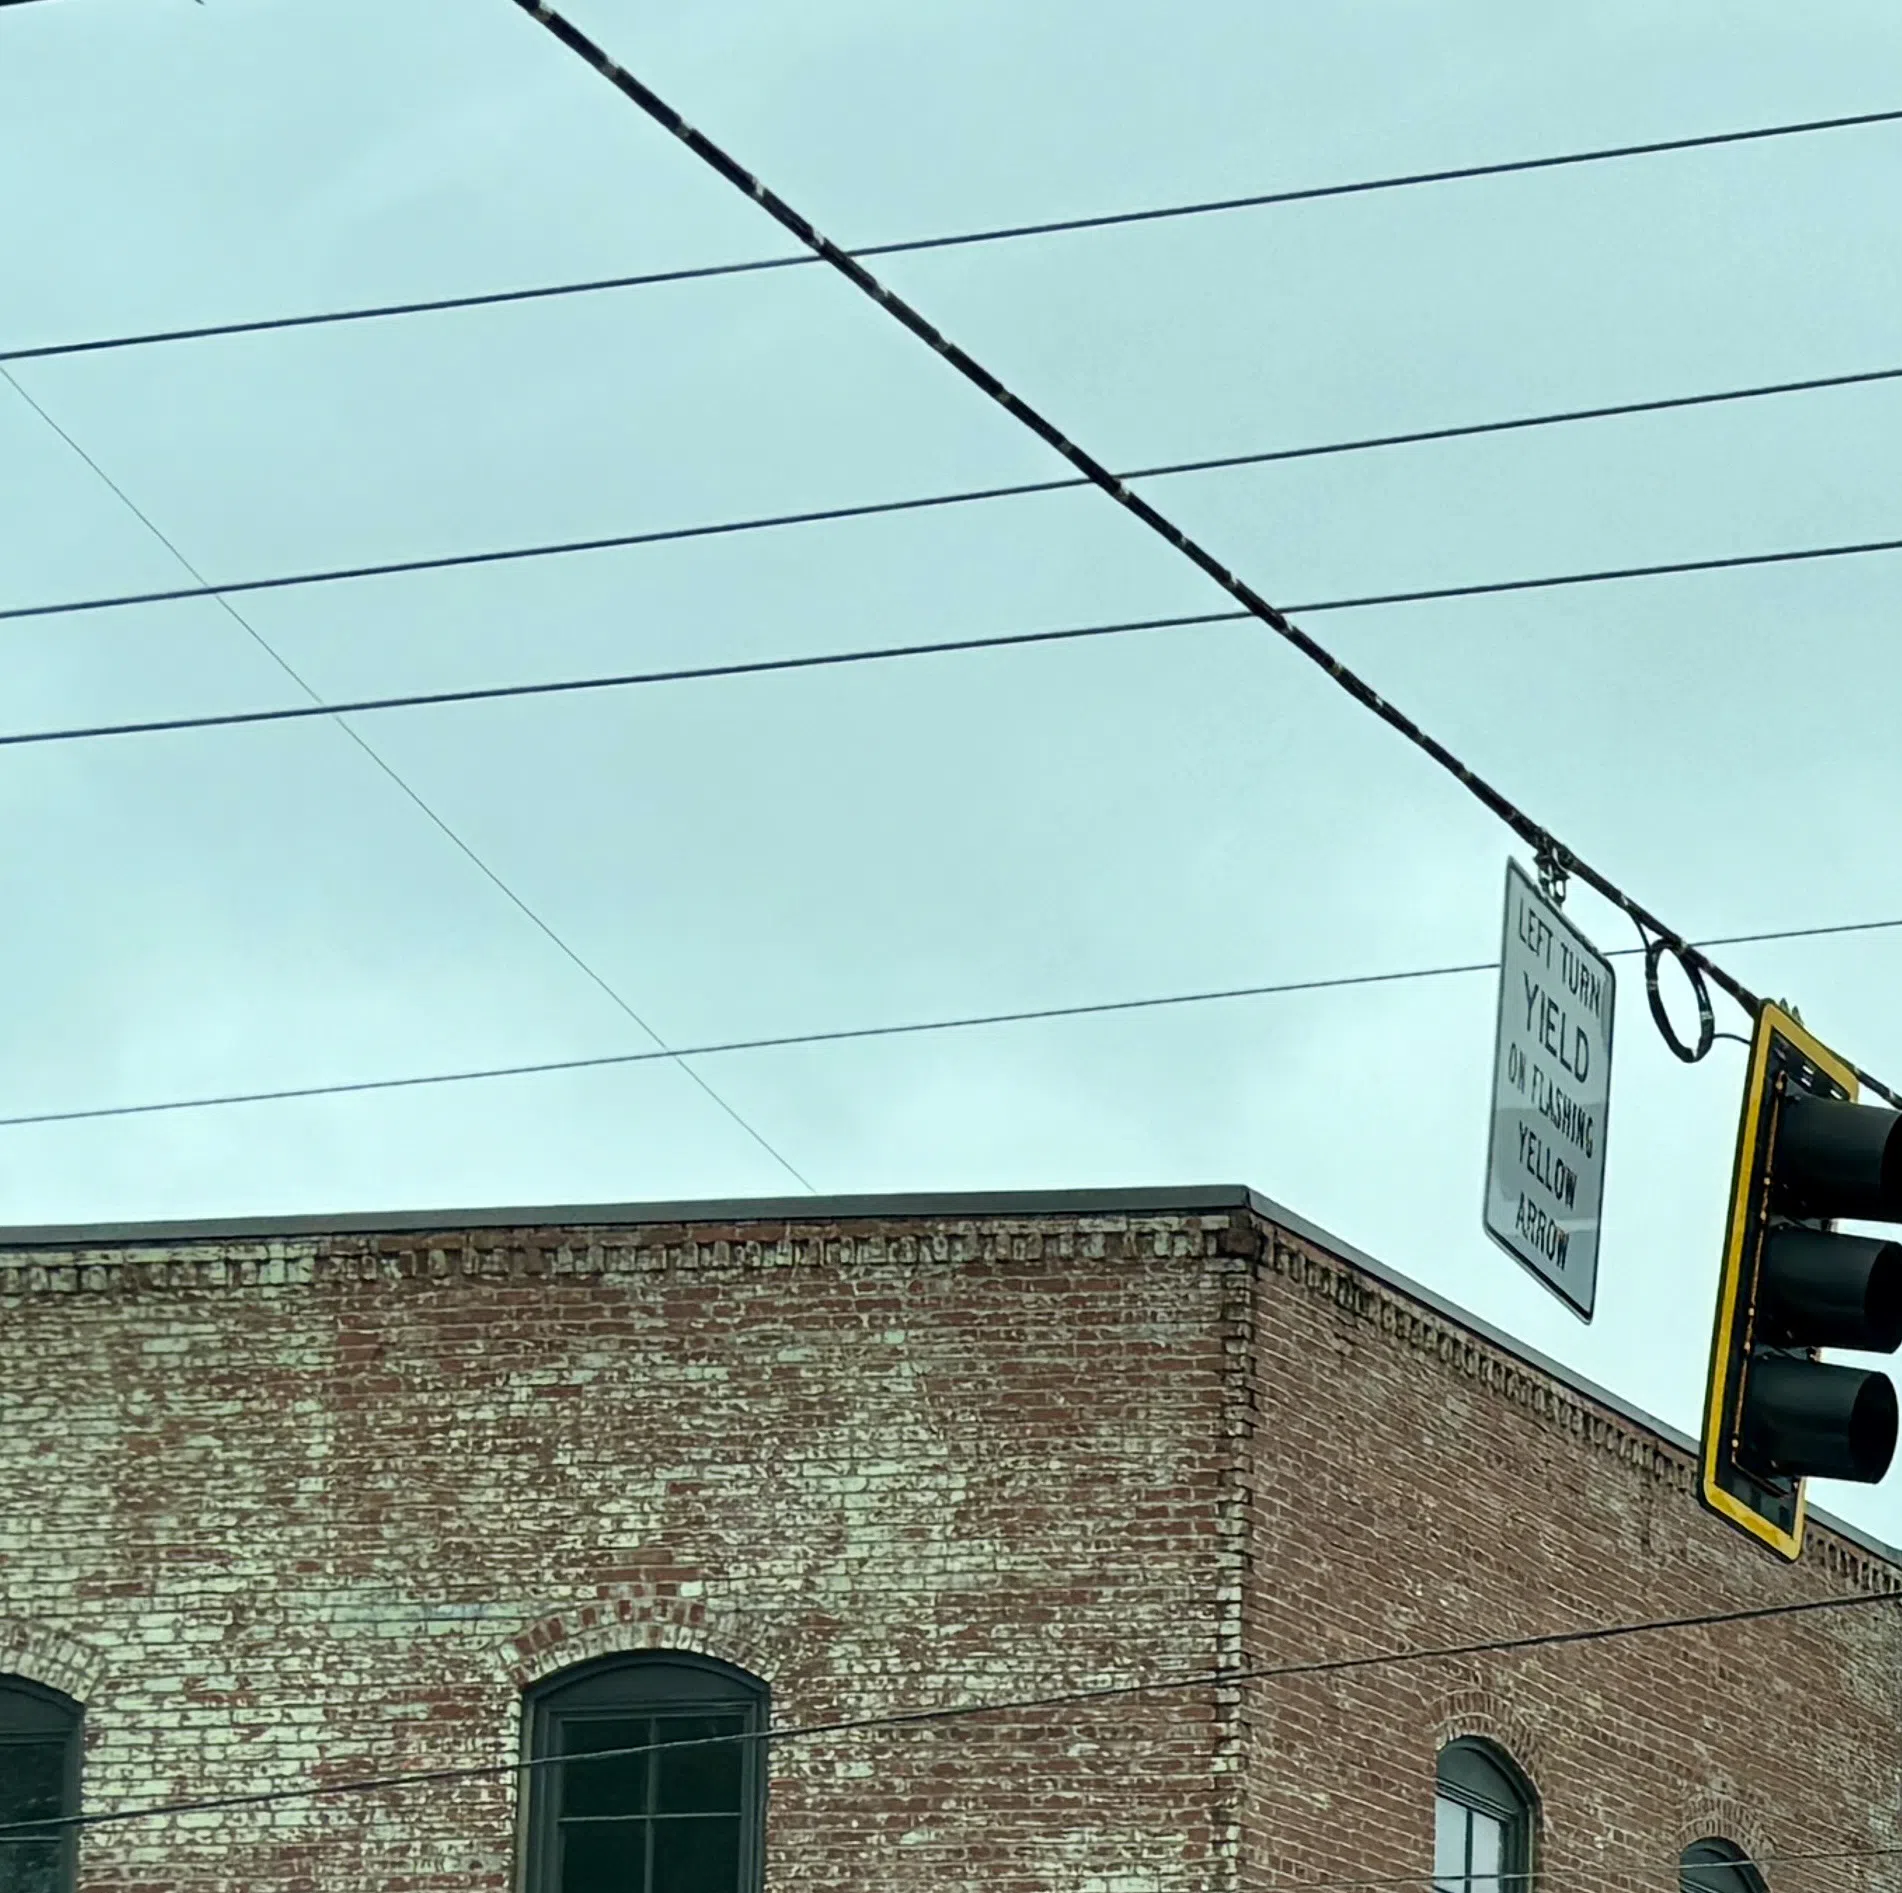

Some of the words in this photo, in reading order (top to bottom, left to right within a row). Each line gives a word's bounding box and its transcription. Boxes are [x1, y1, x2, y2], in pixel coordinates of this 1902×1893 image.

[1518, 897, 1553, 970] LEFT
[1560, 940, 1601, 1018] TURN
[1523, 971, 1591, 1084] YIELD
[1507, 1041, 1527, 1095] ON
[1531, 1063, 1594, 1160] FLASHING
[1518, 1120, 1578, 1212] YELLOW
[1515, 1190, 1568, 1272] ARROW
